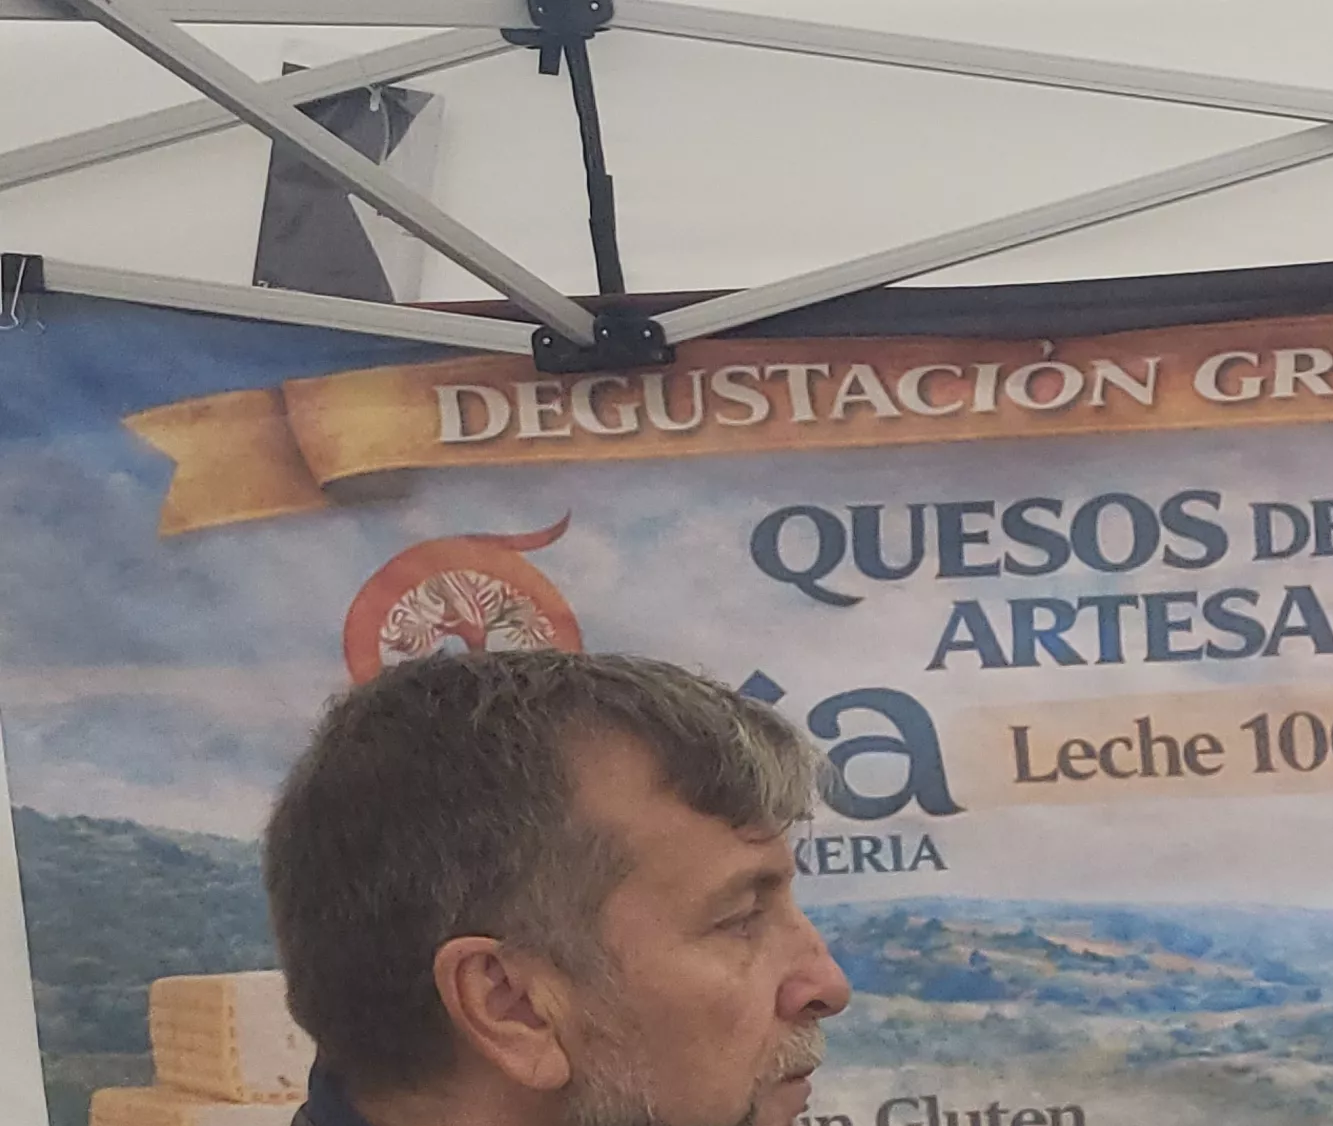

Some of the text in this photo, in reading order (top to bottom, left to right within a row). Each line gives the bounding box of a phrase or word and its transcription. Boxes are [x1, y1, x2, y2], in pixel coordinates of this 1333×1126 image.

[434, 338, 1157, 446] DEGUSTACIÓN
[750, 488, 1228, 606] QUESOS
[1008, 714, 1224, 785] Leche
